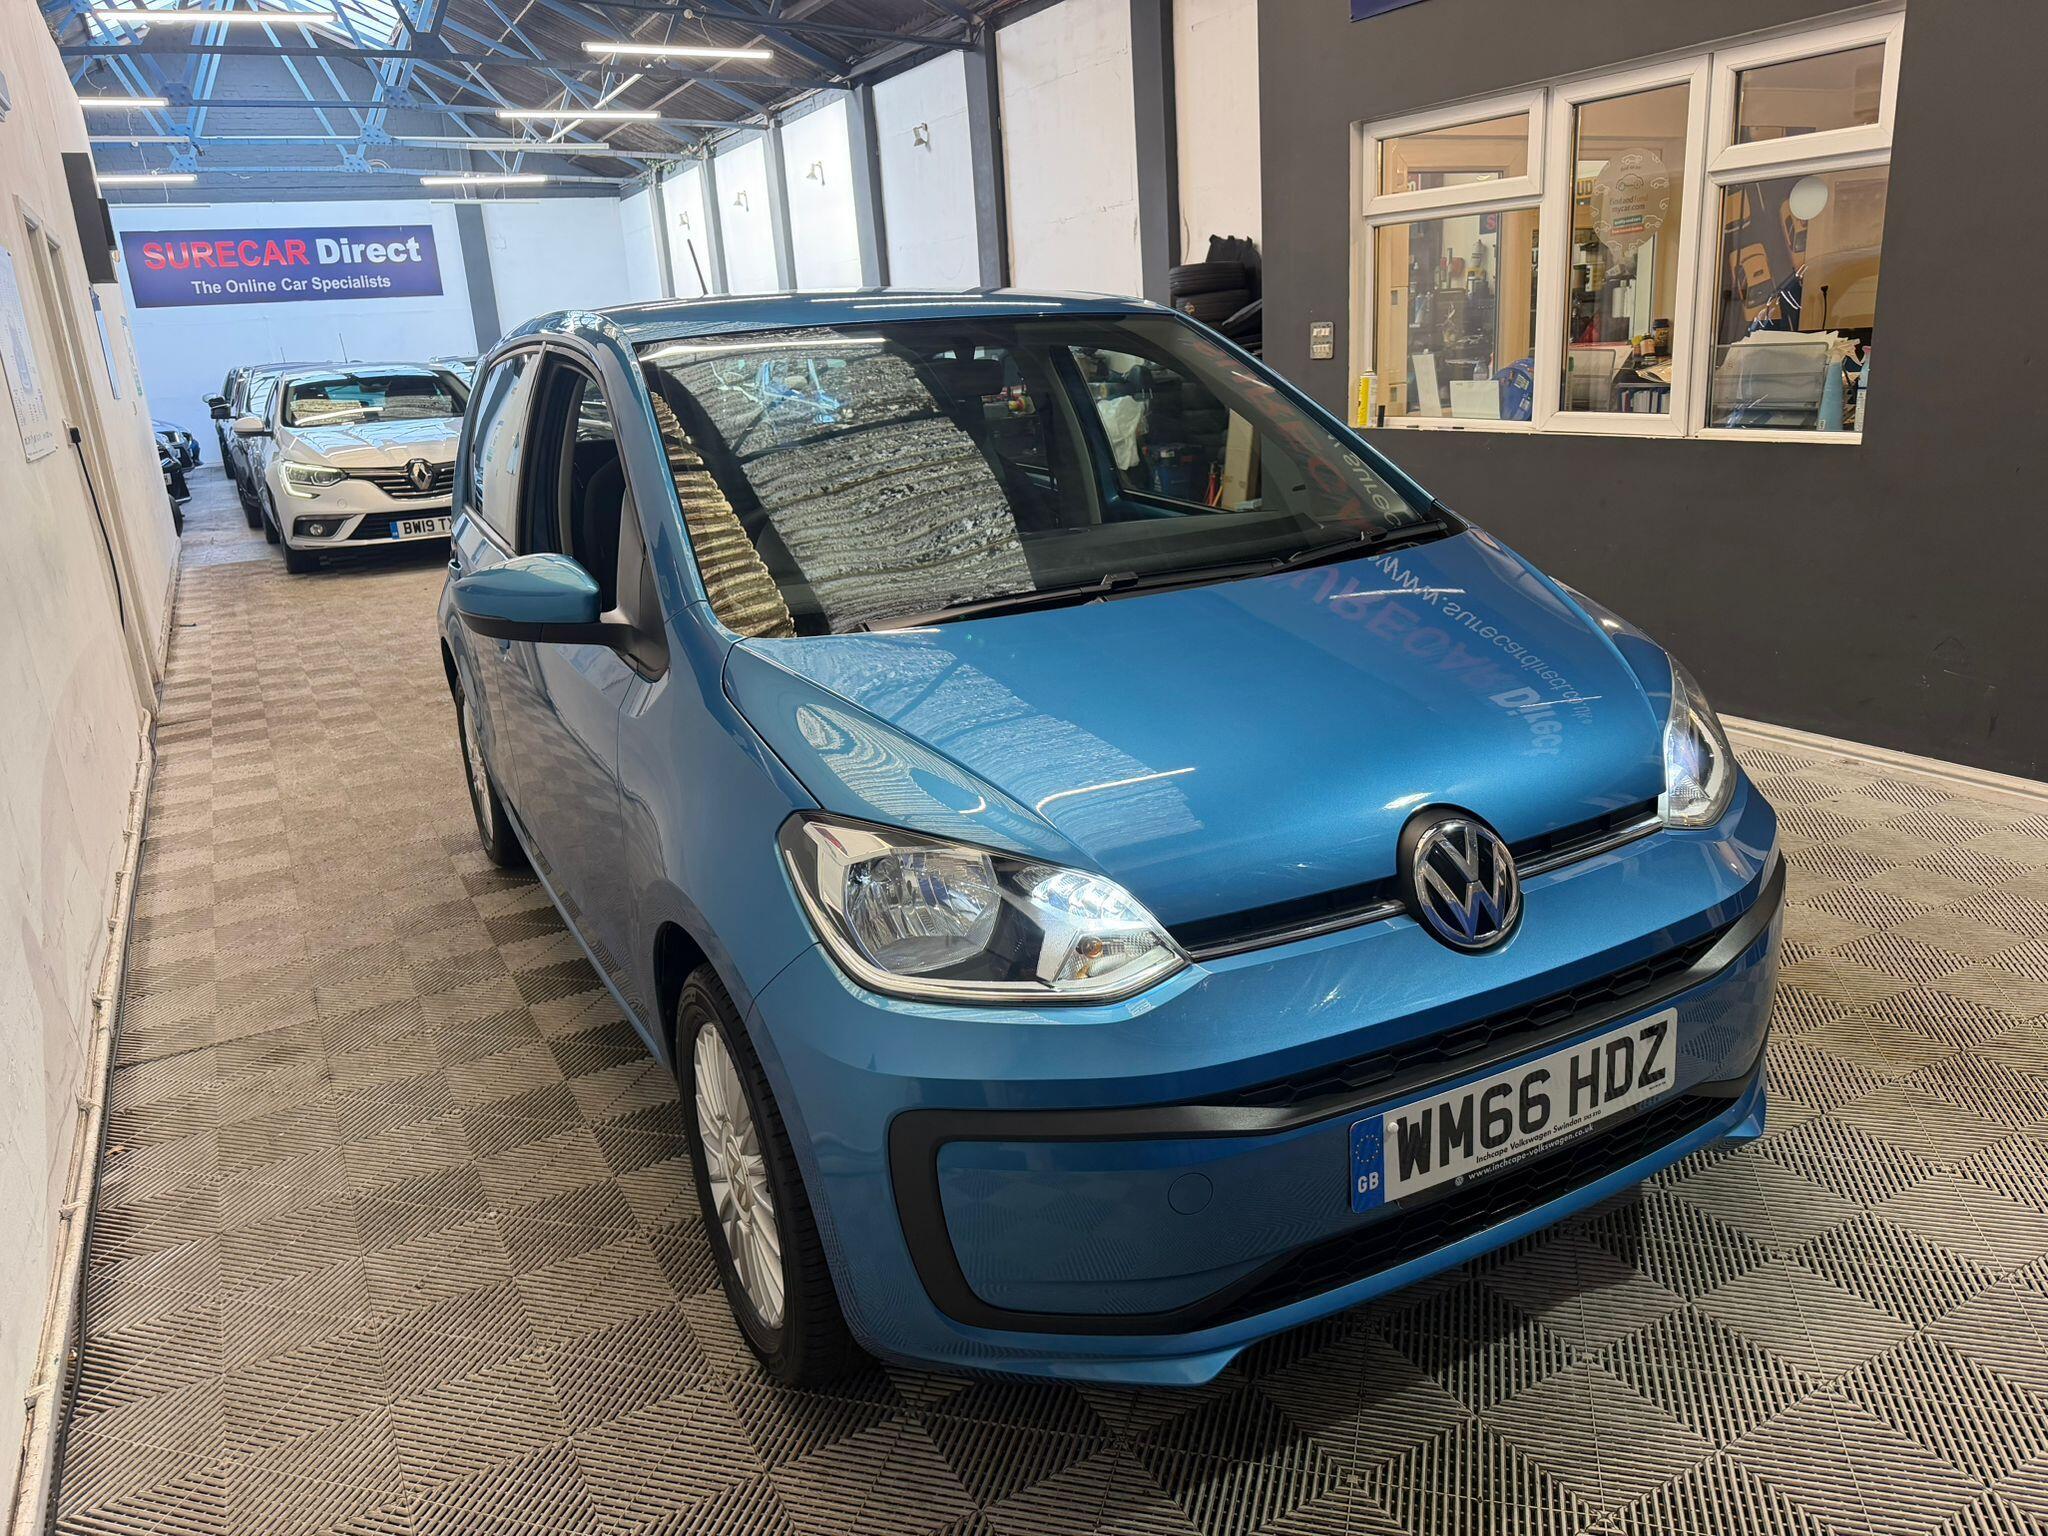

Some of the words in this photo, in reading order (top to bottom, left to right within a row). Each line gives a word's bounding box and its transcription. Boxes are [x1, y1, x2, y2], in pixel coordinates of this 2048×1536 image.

[143, 239, 309, 270] SURECAR
[315, 236, 422, 265] Direct
[191, 279, 222, 295] The
[226, 277, 277, 294] Online
[281, 276, 308, 291] Car
[311, 274, 391, 292] Specialists
[403, 520, 435, 535] BW19
[1397, 1068, 1551, 1182] WM66
[1569, 1020, 1669, 1117] HDZ
[1468, 1122, 1594, 1181] www.inchcape-volkswagen.co.uk
[1476, 1146, 1508, 1164] Inchcape
[1510, 1129, 1552, 1151] Volkswagen
[1553, 1116, 1582, 1134] Swindon
[1357, 1171, 1379, 1195] GB
